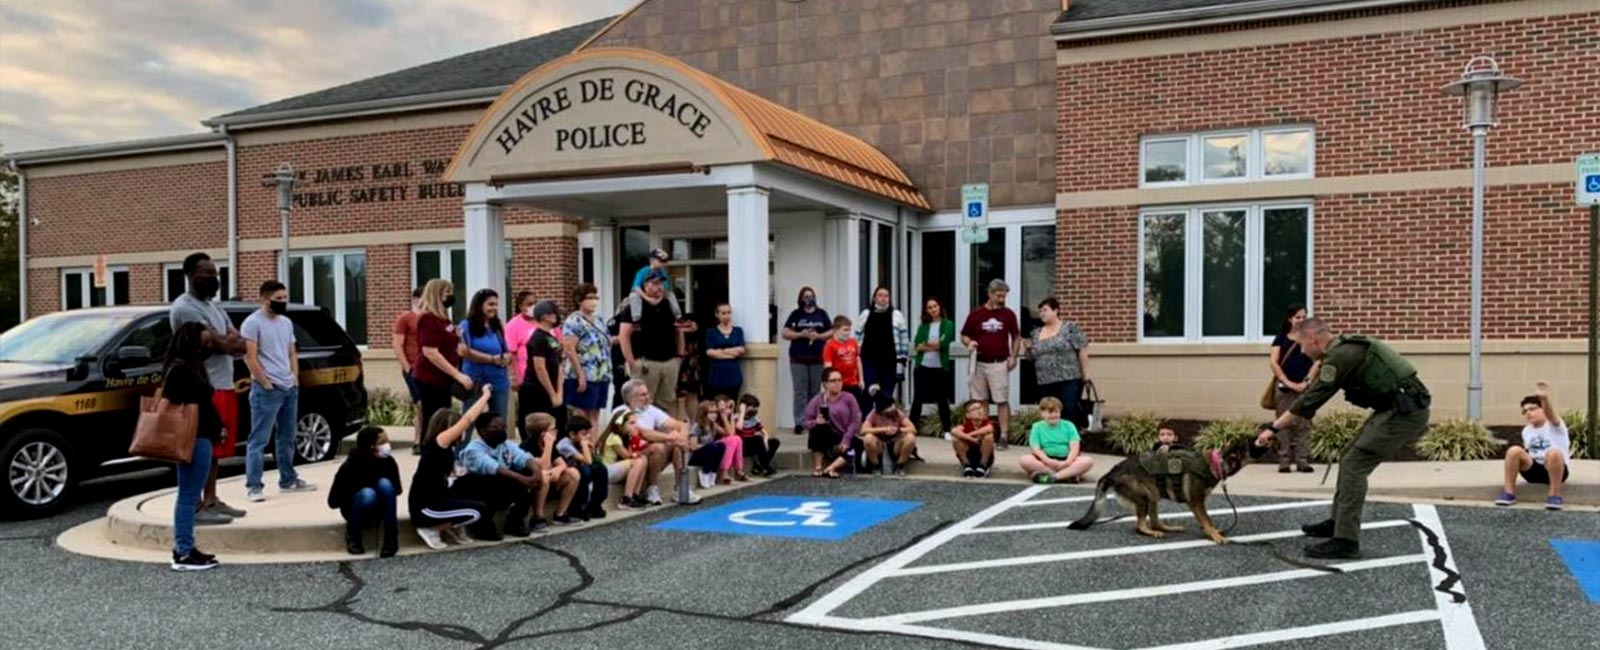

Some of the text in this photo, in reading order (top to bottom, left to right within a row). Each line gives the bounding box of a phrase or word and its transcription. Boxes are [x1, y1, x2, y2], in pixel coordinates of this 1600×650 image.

[496, 78, 711, 154] HAVRE DE GRACE
[556, 122, 647, 151] POLICE
[314, 166, 364, 183] JAMES
[373, 162, 412, 179] EARL
[292, 190, 342, 207] PUBLIC
[350, 185, 407, 203] SAFETY
[105, 377, 134, 388] Havre
[137, 375, 149, 385] de
[74, 397, 97, 410] 1169
